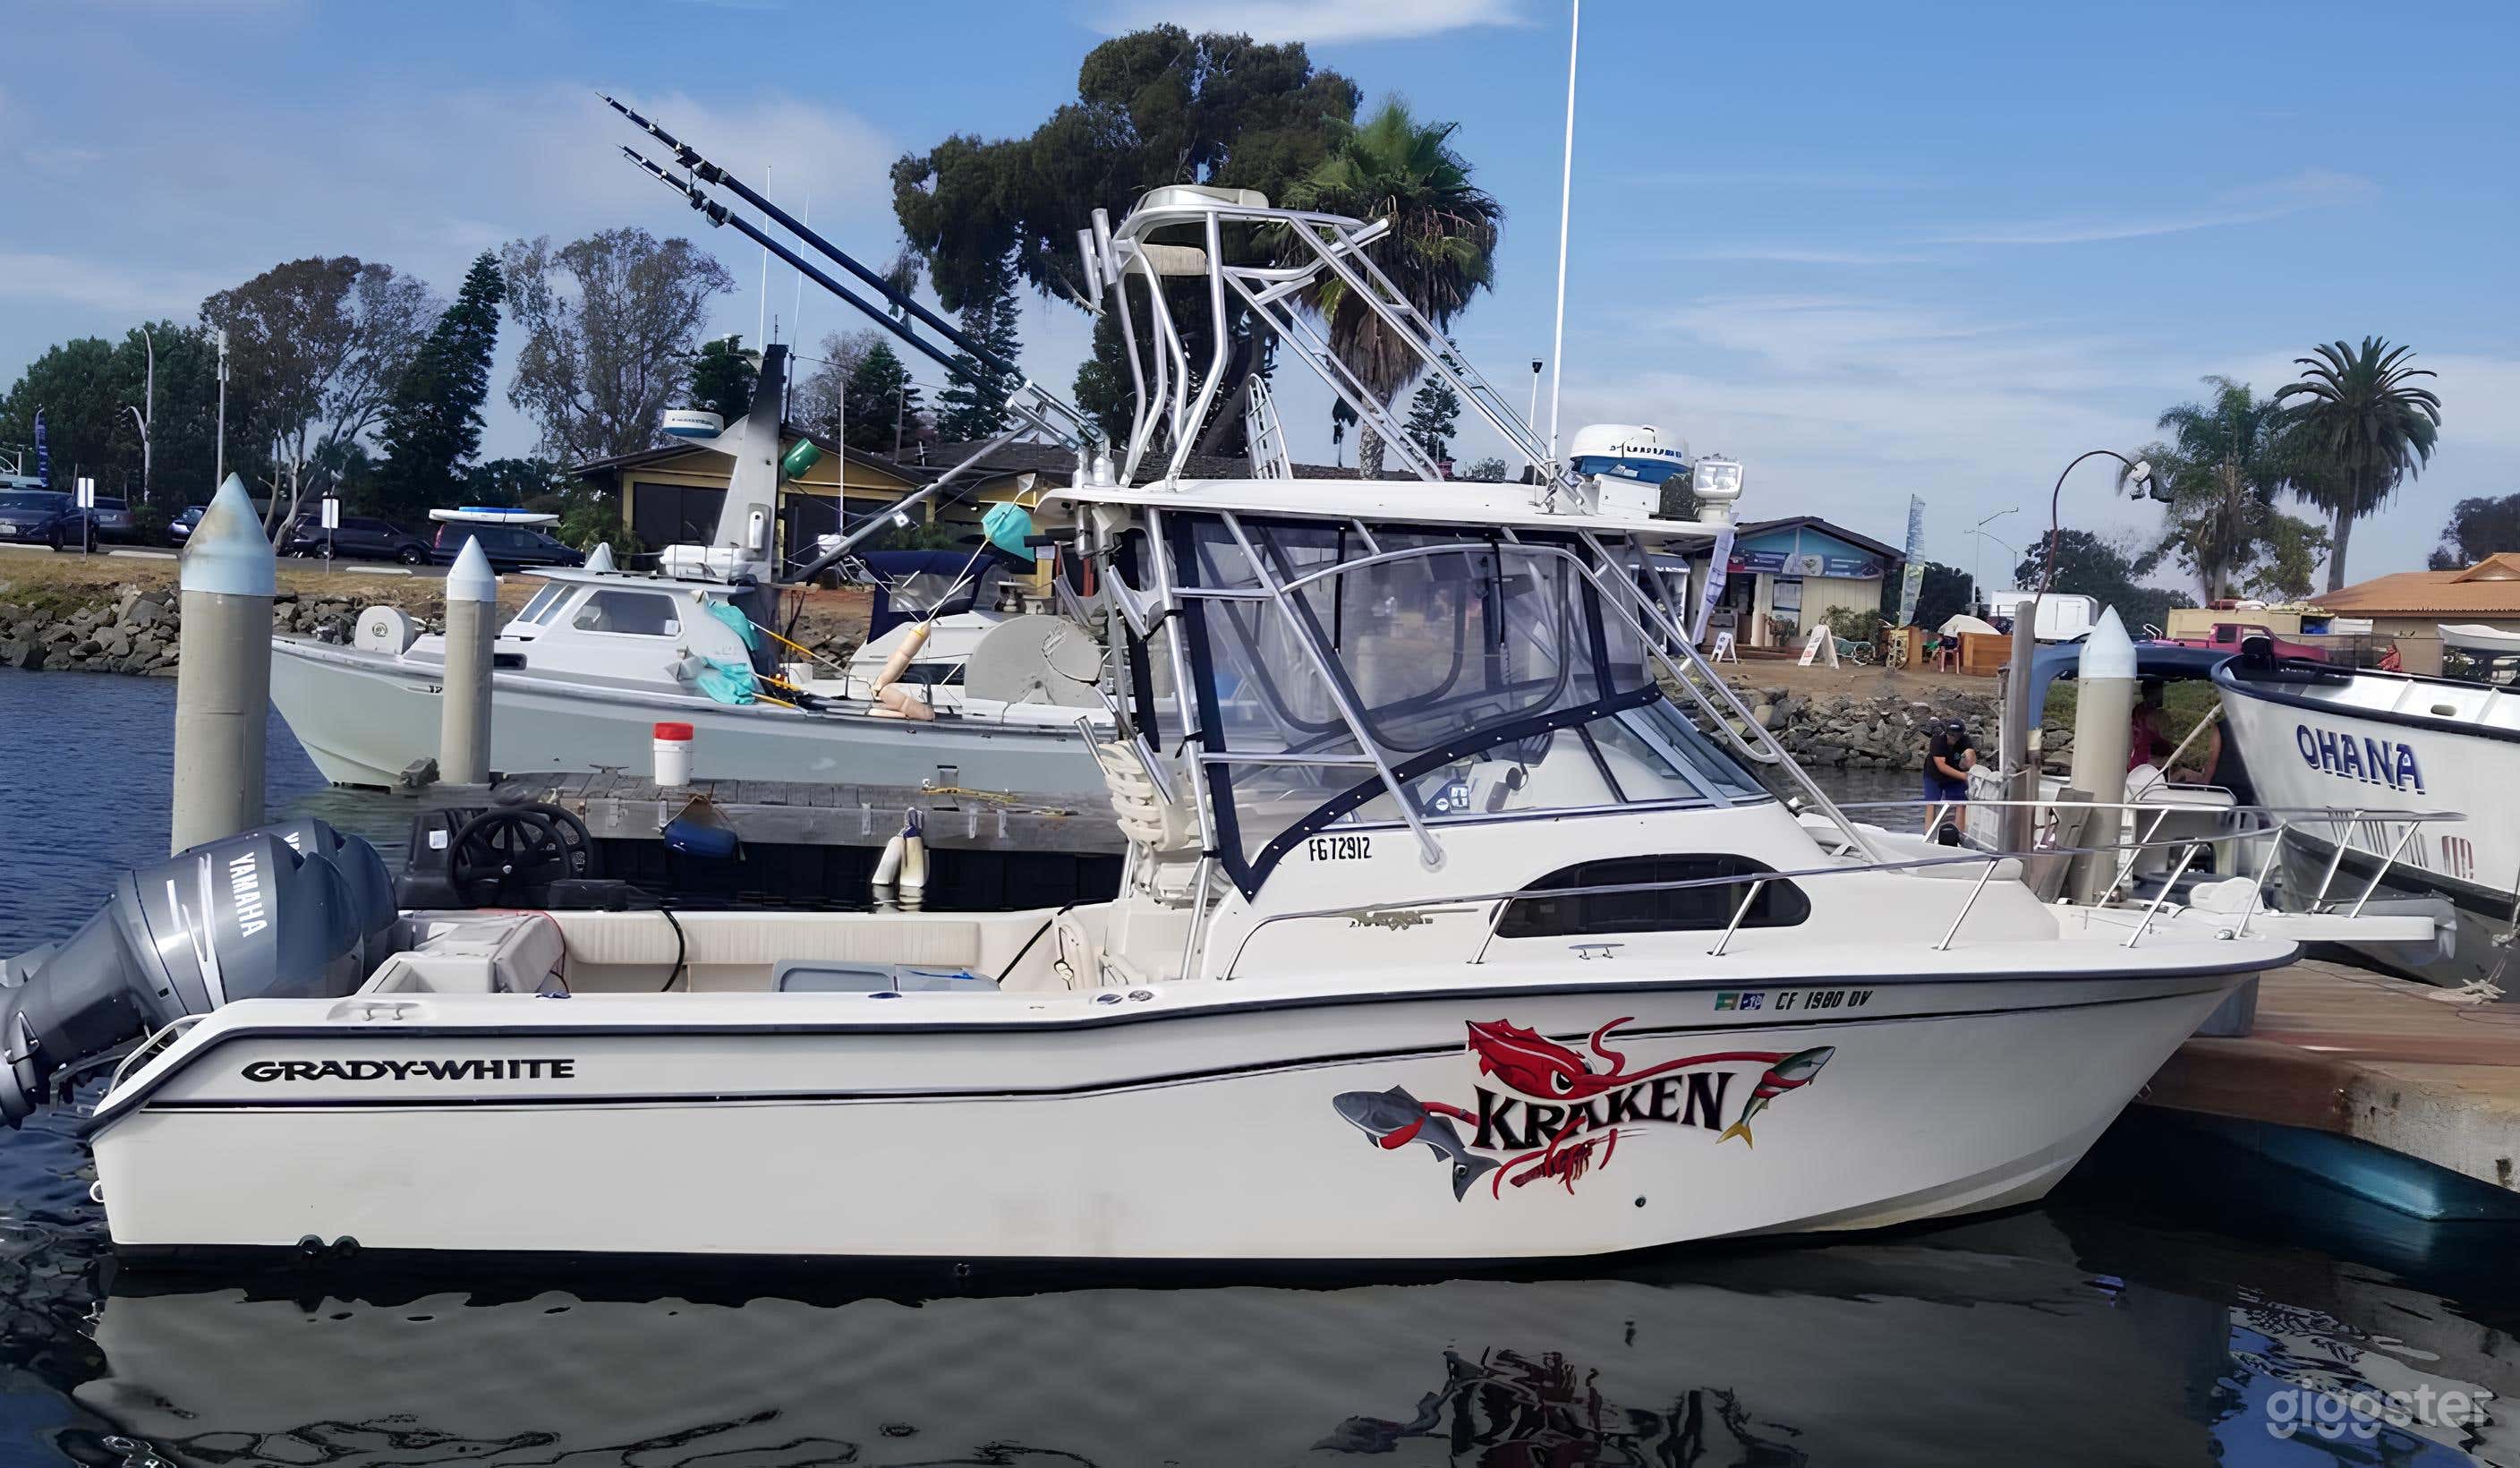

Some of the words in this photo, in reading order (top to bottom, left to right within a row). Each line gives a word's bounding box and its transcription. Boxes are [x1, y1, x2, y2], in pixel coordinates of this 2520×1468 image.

[2296, 724, 2426, 795] OHANA
[229, 851, 268, 938] YAMAHA
[1775, 992, 1799, 1011] CF
[1804, 990, 1845, 1010] 1980
[241, 1059, 575, 1082] GRADY-WHITE
[1470, 1072, 1738, 1150] KRAKEN
